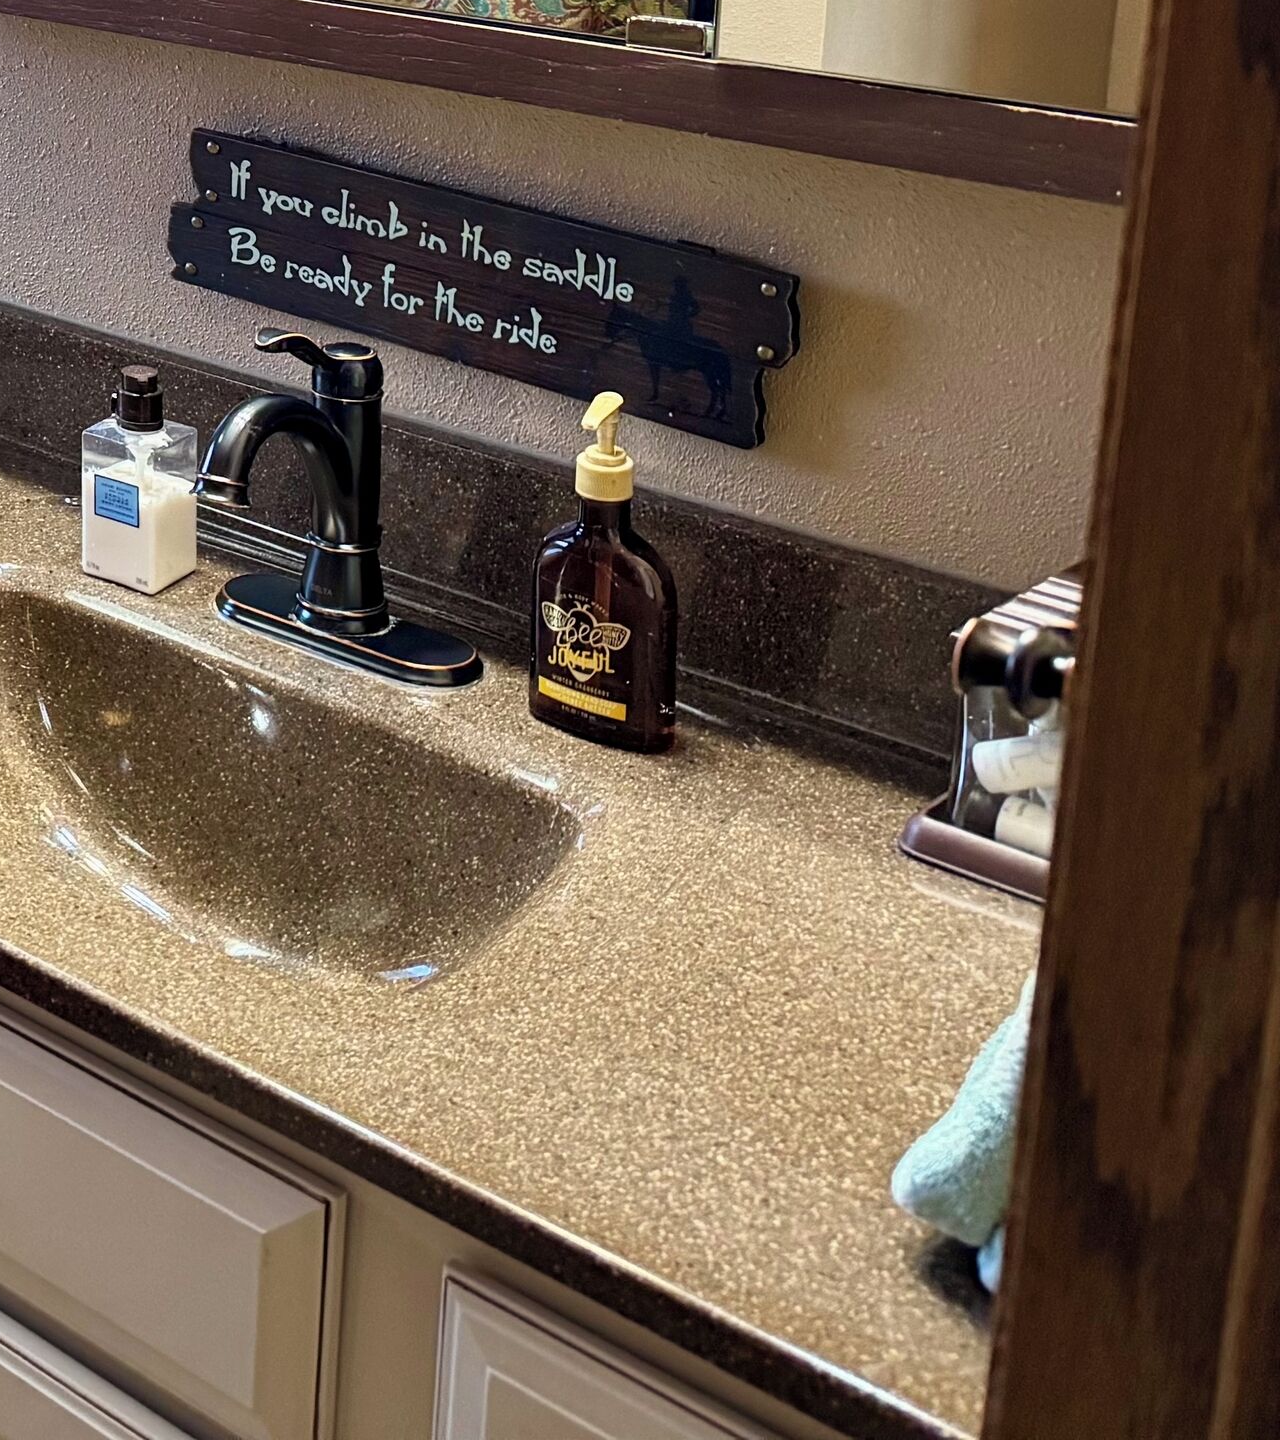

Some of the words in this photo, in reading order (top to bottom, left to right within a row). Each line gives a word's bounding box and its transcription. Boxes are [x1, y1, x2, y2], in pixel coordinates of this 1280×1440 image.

[229, 160, 251, 201] If
[258, 184, 315, 217] you
[321, 188, 408, 240] climb
[419, 220, 448, 254] in
[461, 218, 513, 271] the
[521, 247, 635, 304] saddle
[228, 227, 277, 274] Be
[284, 255, 373, 308] ready
[381, 263, 425, 316] for
[435, 281, 485, 334] the
[492, 307, 558, 355] ride
[547, 645, 616, 674] JOYFUL
[562, 617, 603, 648] bee
